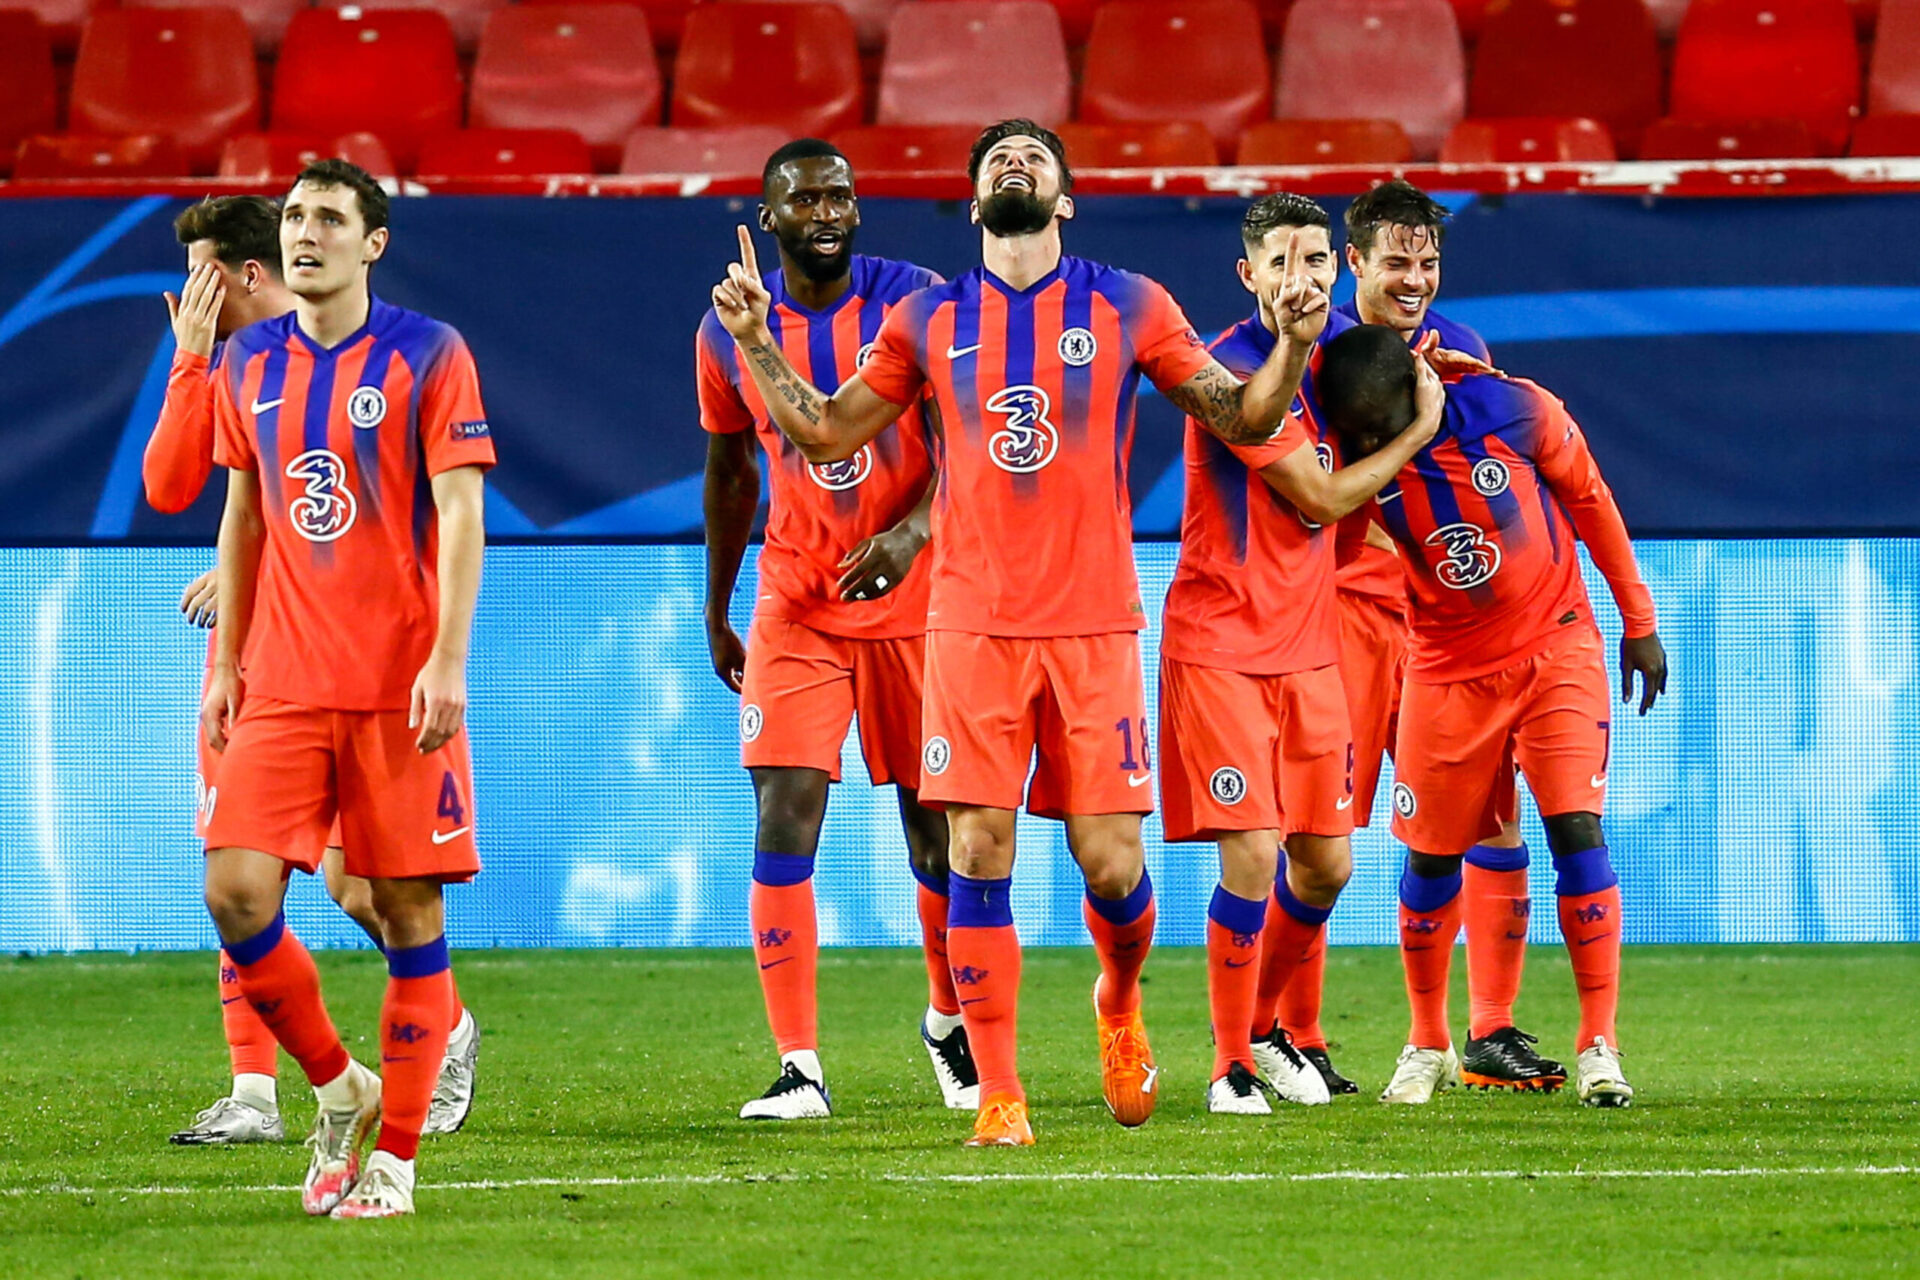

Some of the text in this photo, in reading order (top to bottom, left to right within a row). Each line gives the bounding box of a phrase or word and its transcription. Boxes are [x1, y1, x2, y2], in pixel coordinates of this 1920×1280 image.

[985, 384, 1059, 473] 3
[285, 448, 357, 542] 3
[1424, 522, 1502, 590] 3
[1115, 717, 1151, 770] 18
[437, 770, 464, 825] 4
